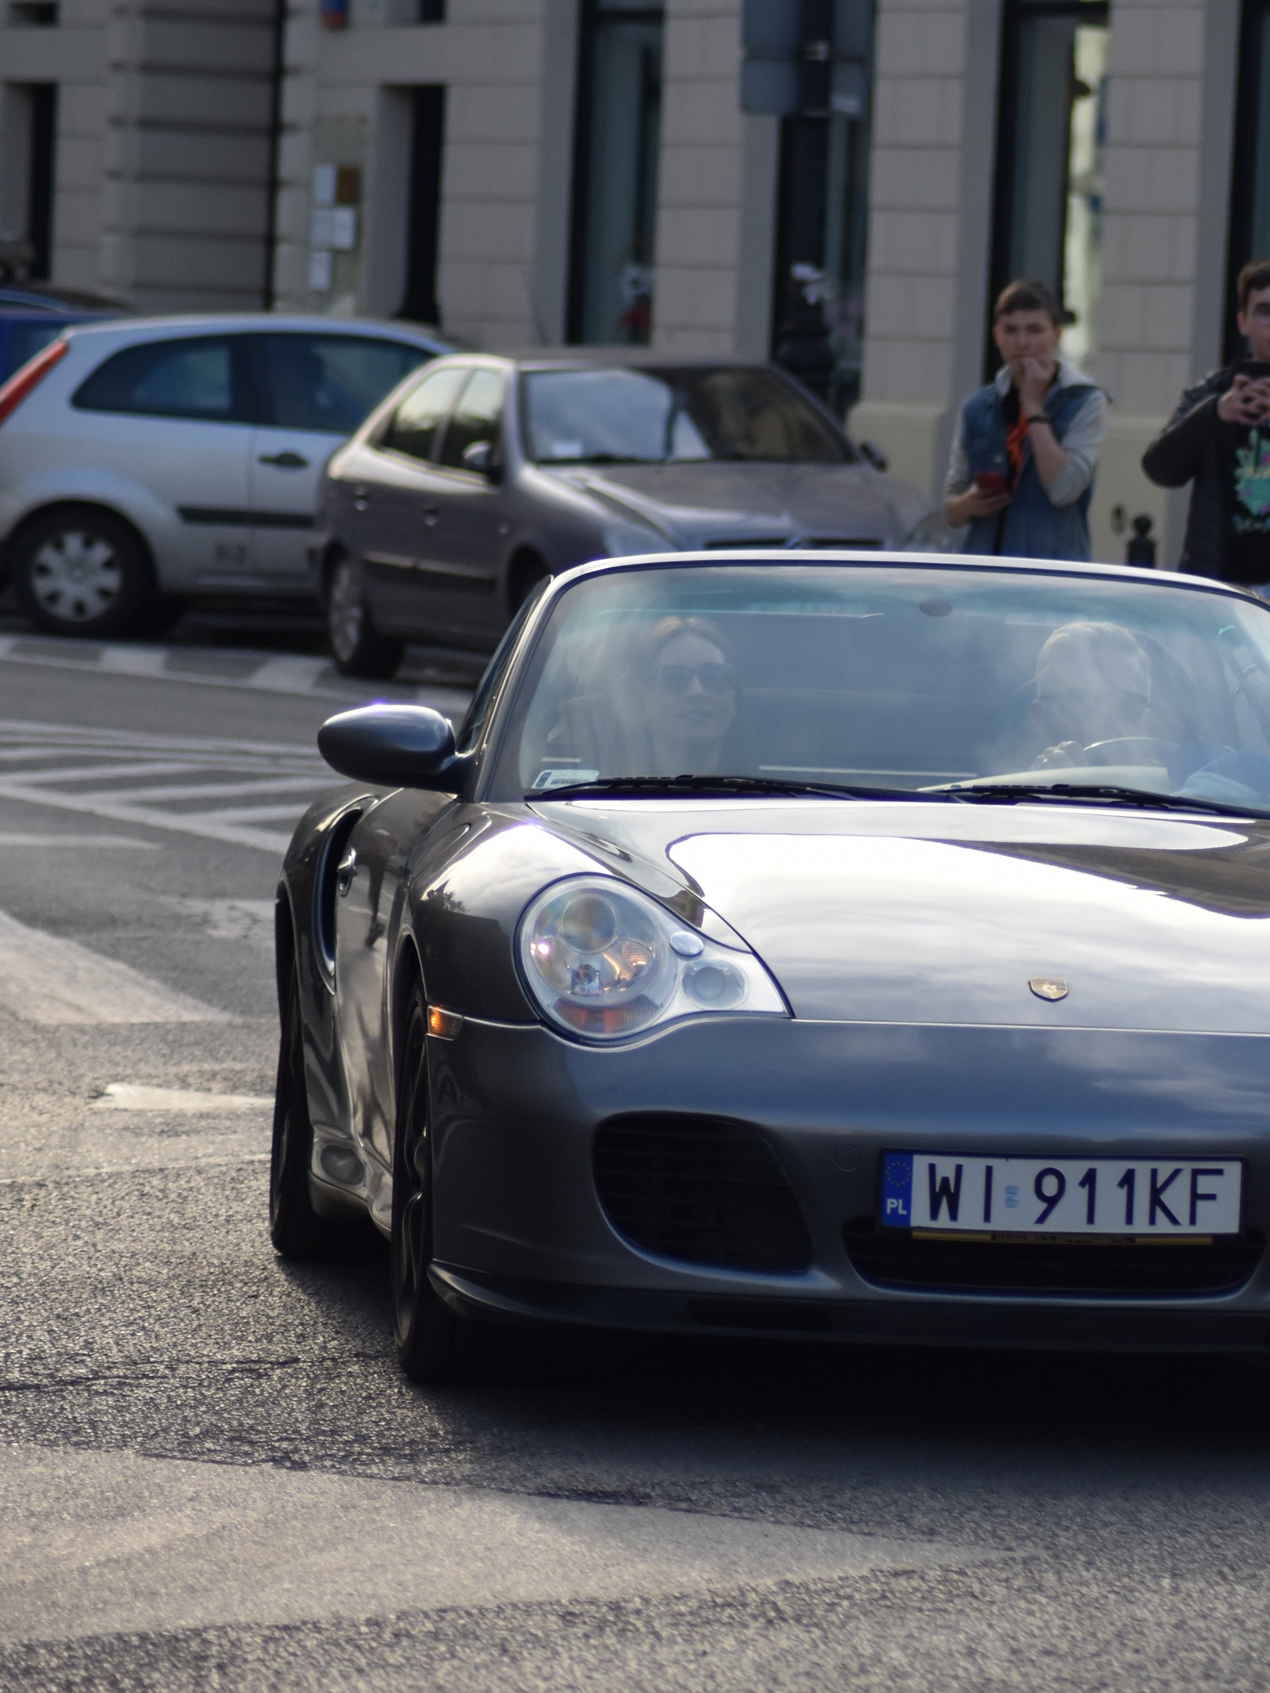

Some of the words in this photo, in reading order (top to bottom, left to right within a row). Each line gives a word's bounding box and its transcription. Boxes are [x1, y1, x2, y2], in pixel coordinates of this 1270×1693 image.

[886, 1198, 907, 1215] PL
[928, 1163, 993, 1223] WI
[1034, 1167, 1224, 1226] 911KF
